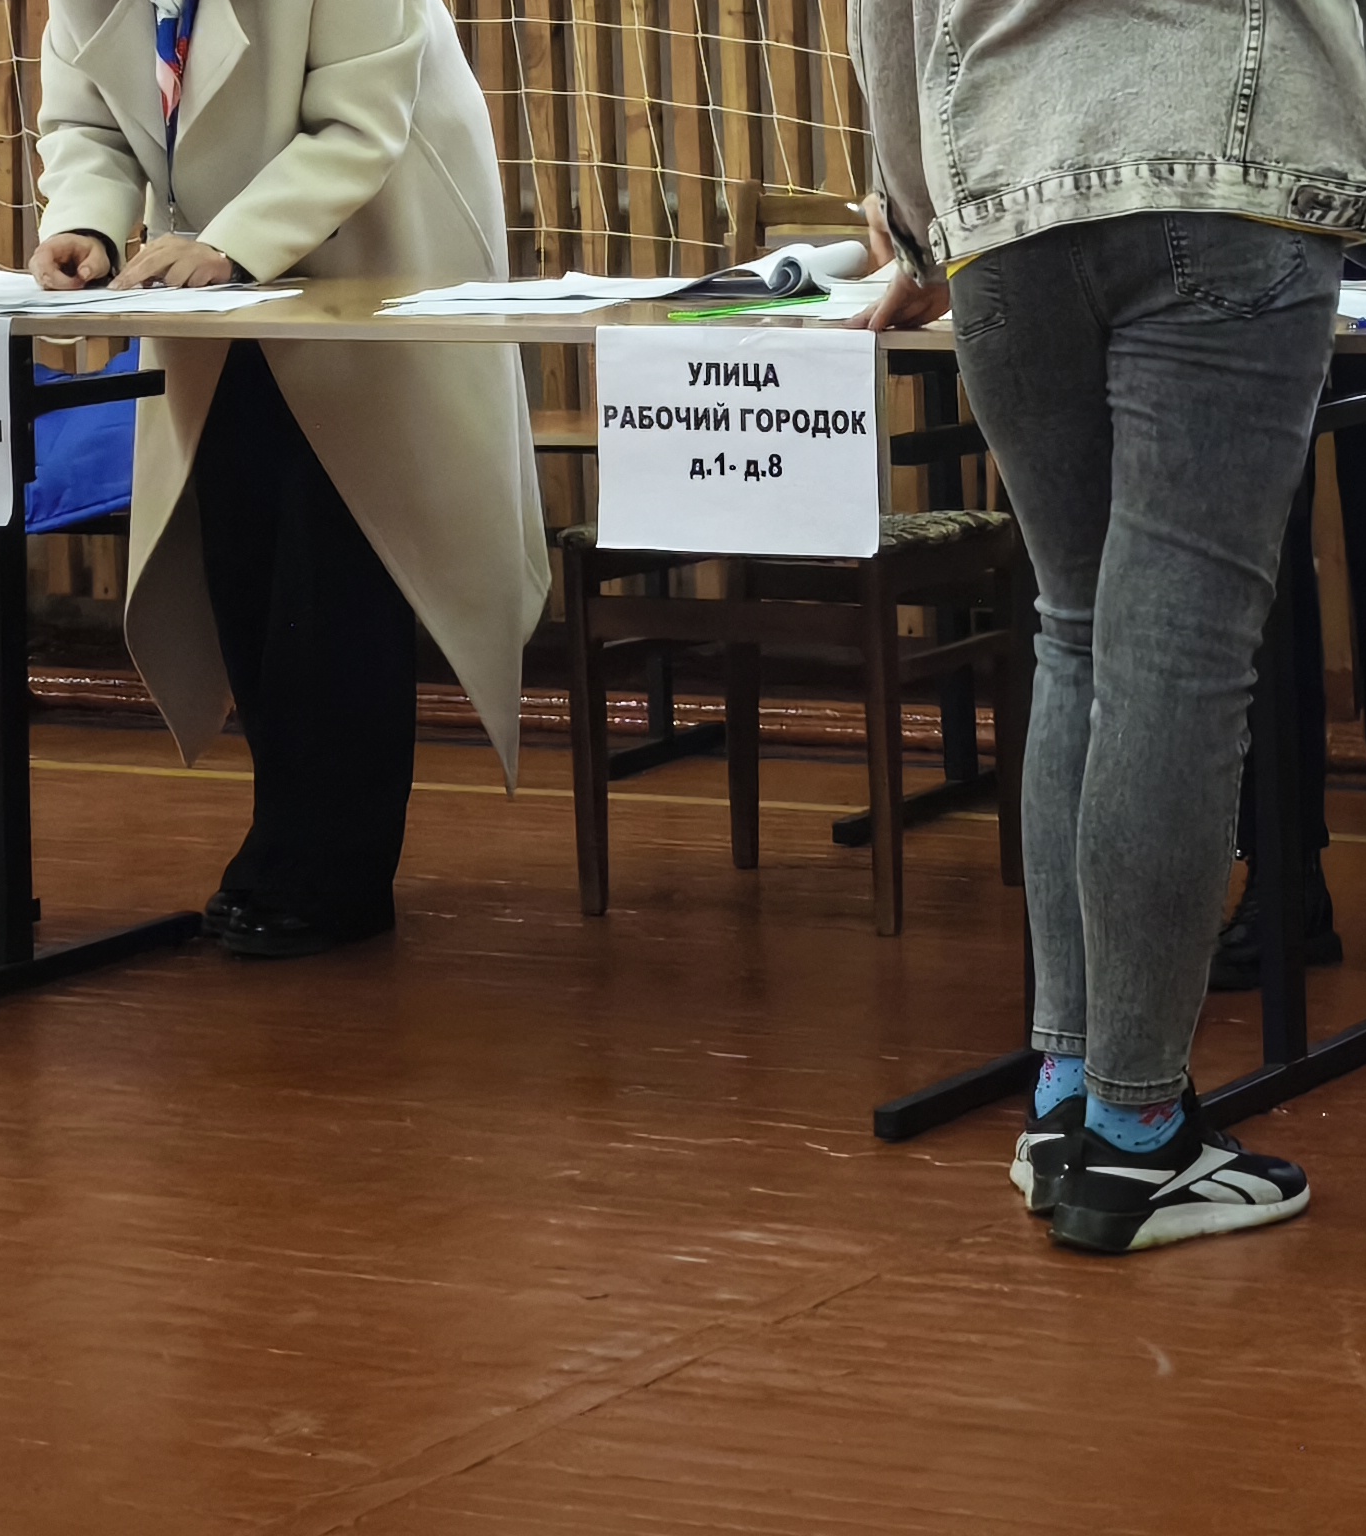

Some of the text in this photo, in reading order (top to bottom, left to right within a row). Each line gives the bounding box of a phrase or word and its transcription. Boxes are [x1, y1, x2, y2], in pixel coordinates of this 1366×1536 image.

[688, 361, 780, 392] УЛИЦА
[603, 402, 867, 439] РАБОЧИЙ ГОРОДОК
[744, 453, 783, 482] д.8
